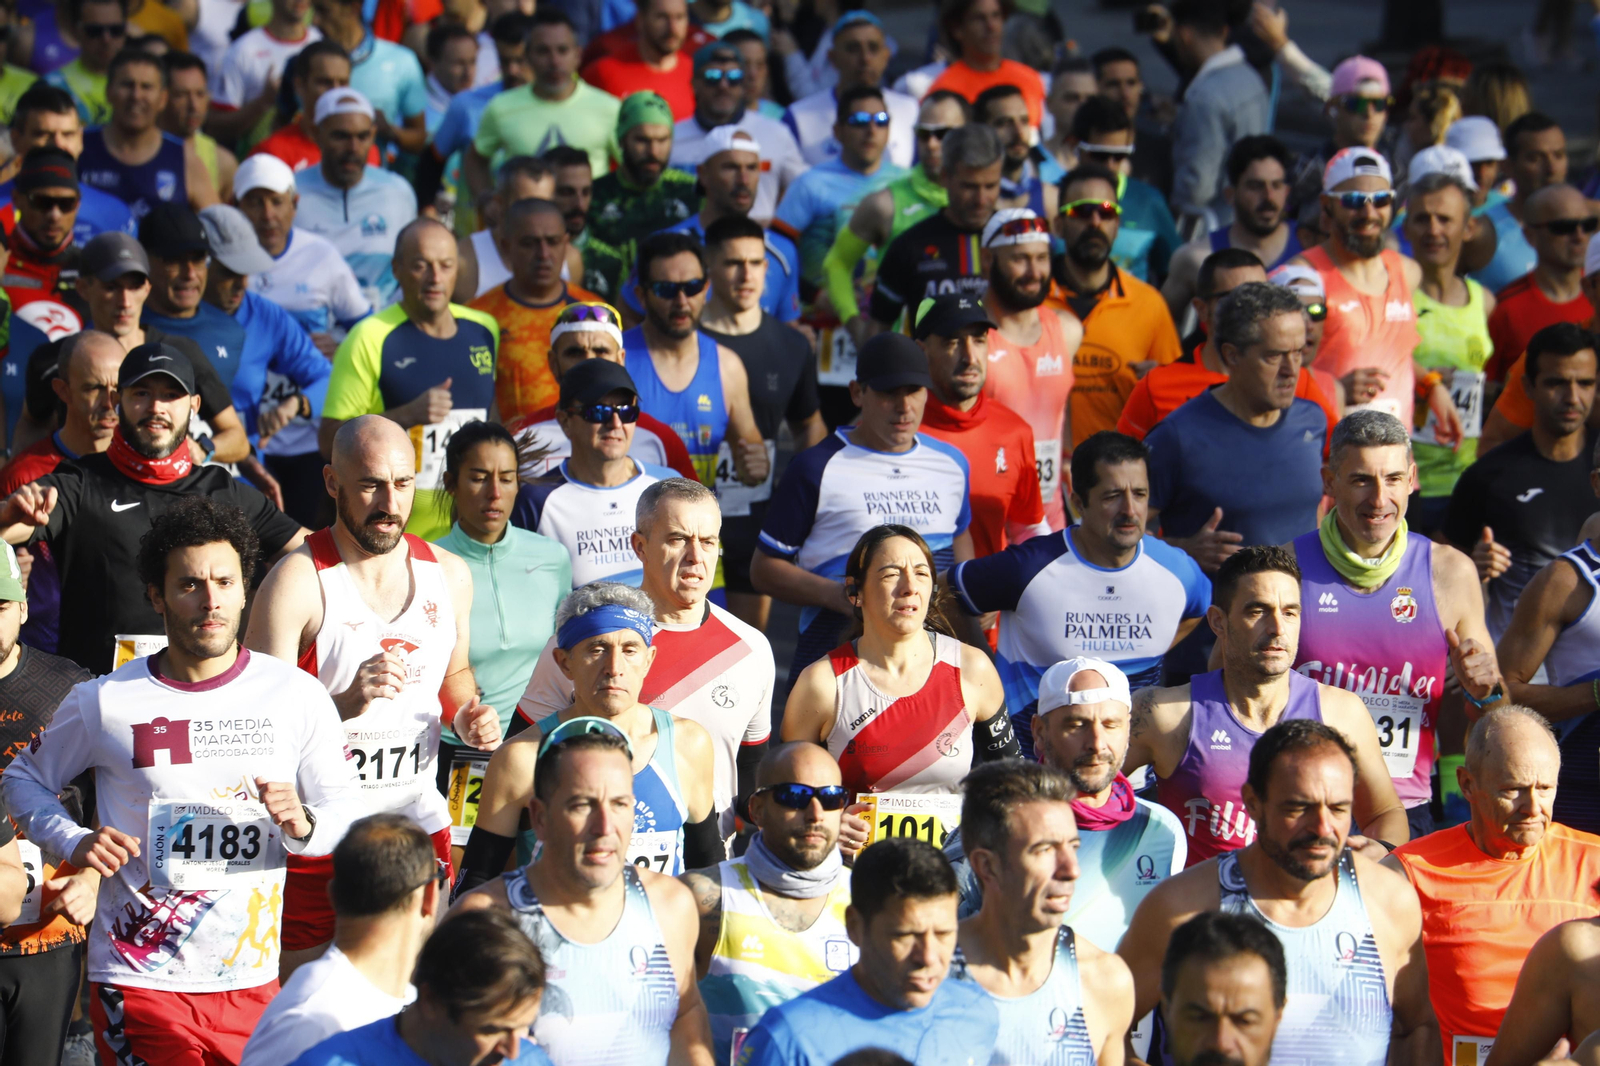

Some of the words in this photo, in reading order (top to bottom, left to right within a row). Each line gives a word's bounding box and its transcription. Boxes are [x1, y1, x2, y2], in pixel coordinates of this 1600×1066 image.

[863, 490, 922, 501] RUNNERS
[925, 490, 940, 500] LA
[866, 501, 942, 515] PALMERA
[576, 525, 636, 541] RUNNERS
[1065, 611, 1131, 625] RUNNERS
[1136, 613, 1153, 624] LA
[1064, 623, 1153, 640] PALMERA
[153, 725, 167, 735] 35
[193, 720, 214, 733] 35
[218, 717, 274, 731] MEDIA
[193, 730, 275, 747] MARATÓN
[360, 730, 400, 742] IMDECO
[194, 747, 250, 759] CÓRDOBA
[250, 747, 275, 757] 2019
[350, 742, 421, 781] 2171
[891, 798, 932, 809] IMDECO
[188, 805, 234, 817] IMDECO
[171, 823, 261, 861] 4183
[155, 836, 165, 869] CAJÓN
